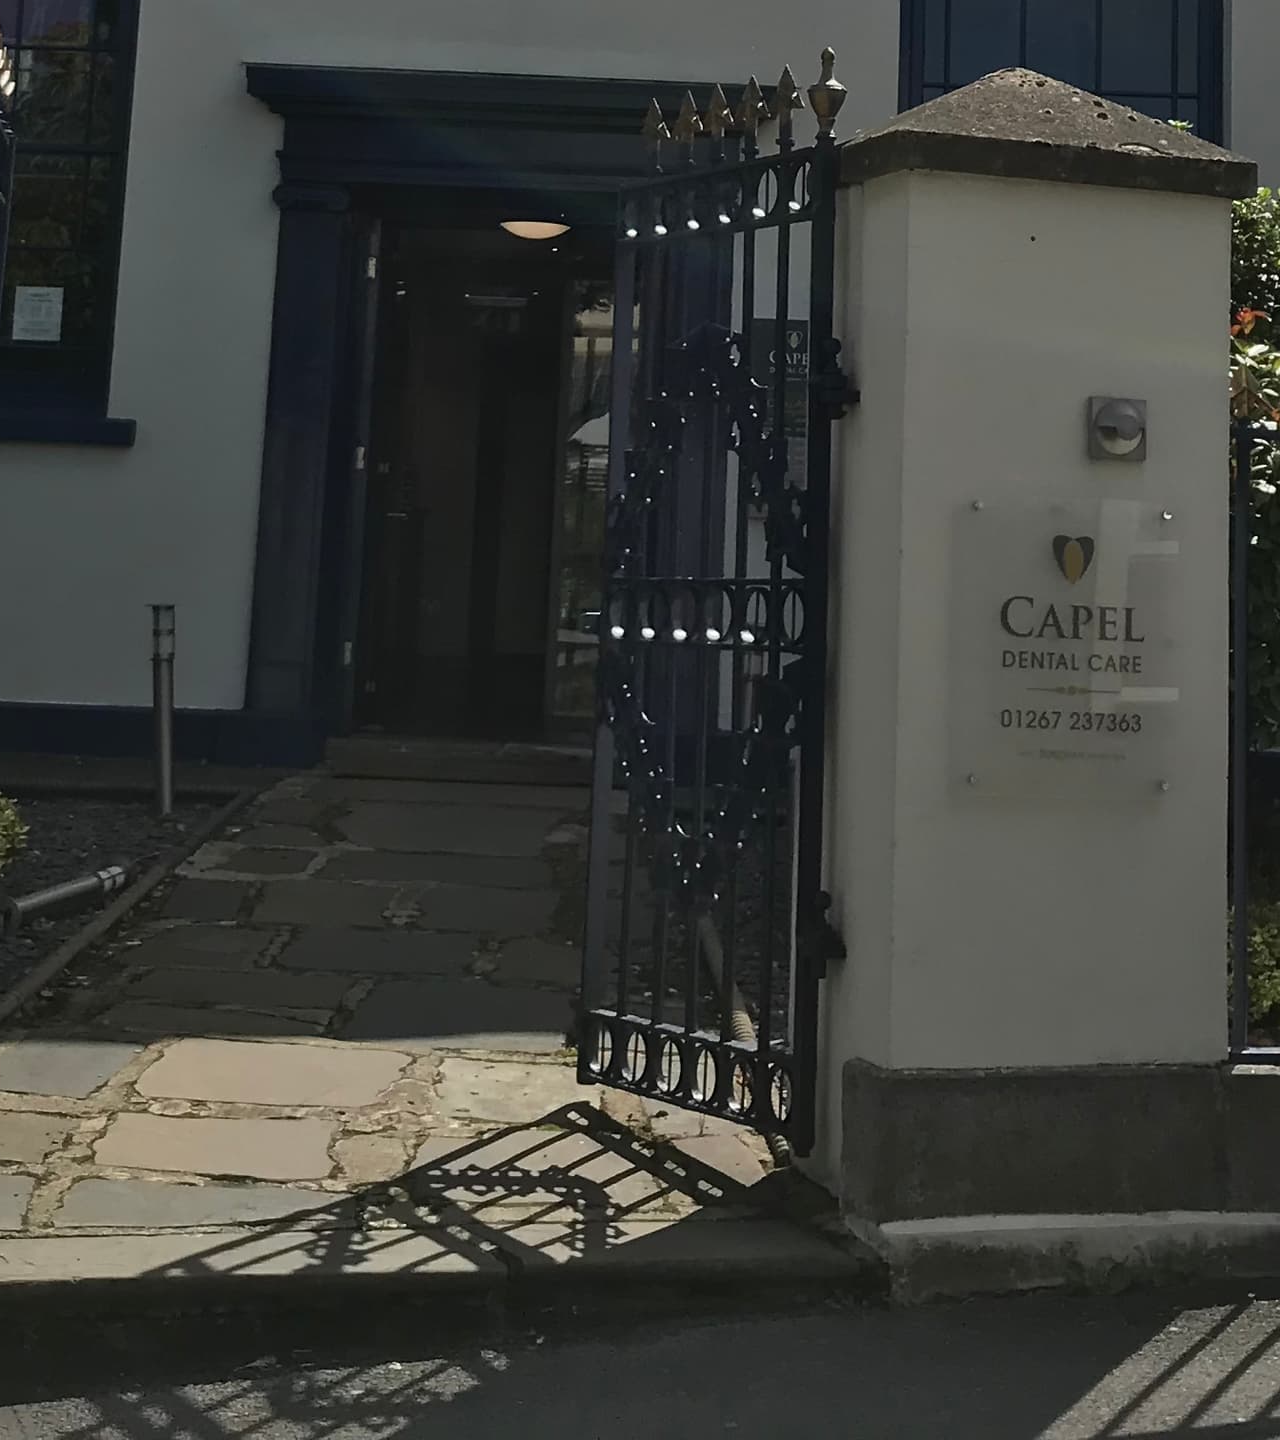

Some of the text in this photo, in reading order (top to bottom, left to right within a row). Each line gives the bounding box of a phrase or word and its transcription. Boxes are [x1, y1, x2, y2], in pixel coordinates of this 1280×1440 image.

[1000, 595, 1145, 642] CAPEL
[1002, 650, 1142, 674] DENTAL CARE
[1000, 709, 1142, 733] 01267 237363
